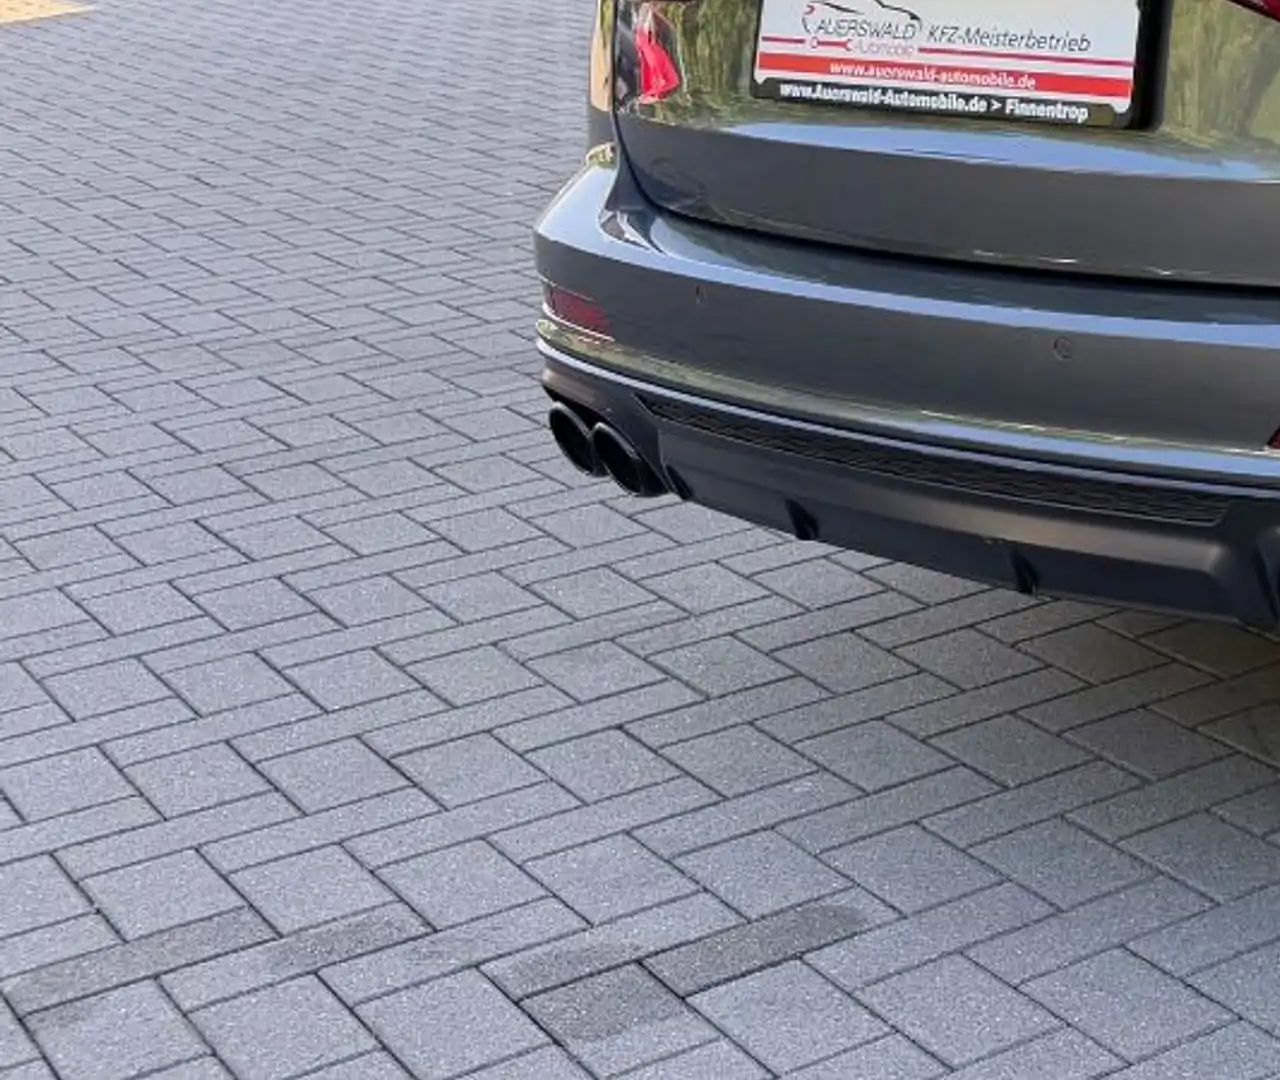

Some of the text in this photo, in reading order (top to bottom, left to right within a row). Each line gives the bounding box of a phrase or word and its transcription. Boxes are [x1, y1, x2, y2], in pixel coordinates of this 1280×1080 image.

[815, 17, 917, 41] AUERSWALD
[926, 24, 1092, 53] KFZ-Meisterbetrieb
[829, 62, 1036, 92] www.auerswald-automobile.de
[779, 83, 988, 113] www.Auerswald-Automobile.de
[1005, 98, 1089, 124] Finnentrop
